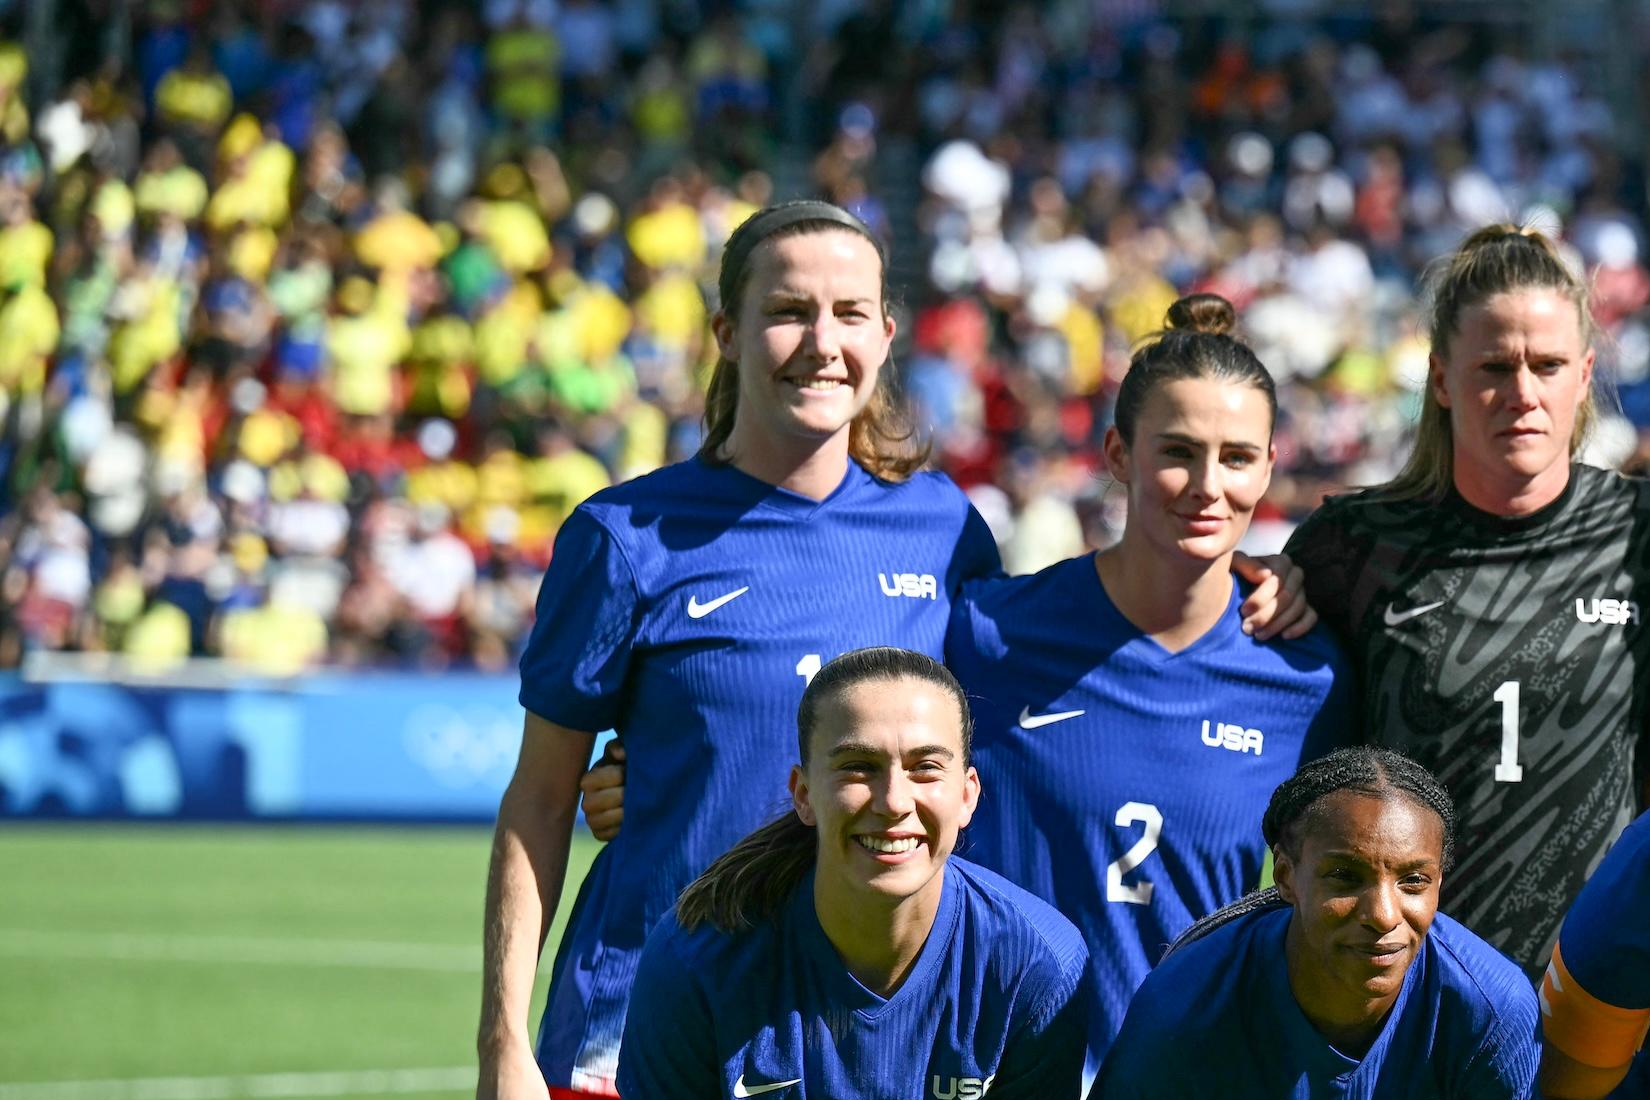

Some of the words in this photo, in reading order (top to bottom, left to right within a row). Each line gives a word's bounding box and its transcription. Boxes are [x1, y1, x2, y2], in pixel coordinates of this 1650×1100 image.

[878, 572, 937, 601] USA
[1575, 598, 1639, 625] USA
[1201, 719, 1265, 756] USA
[1493, 681, 1523, 782] 1
[1106, 801, 1164, 906] 2
